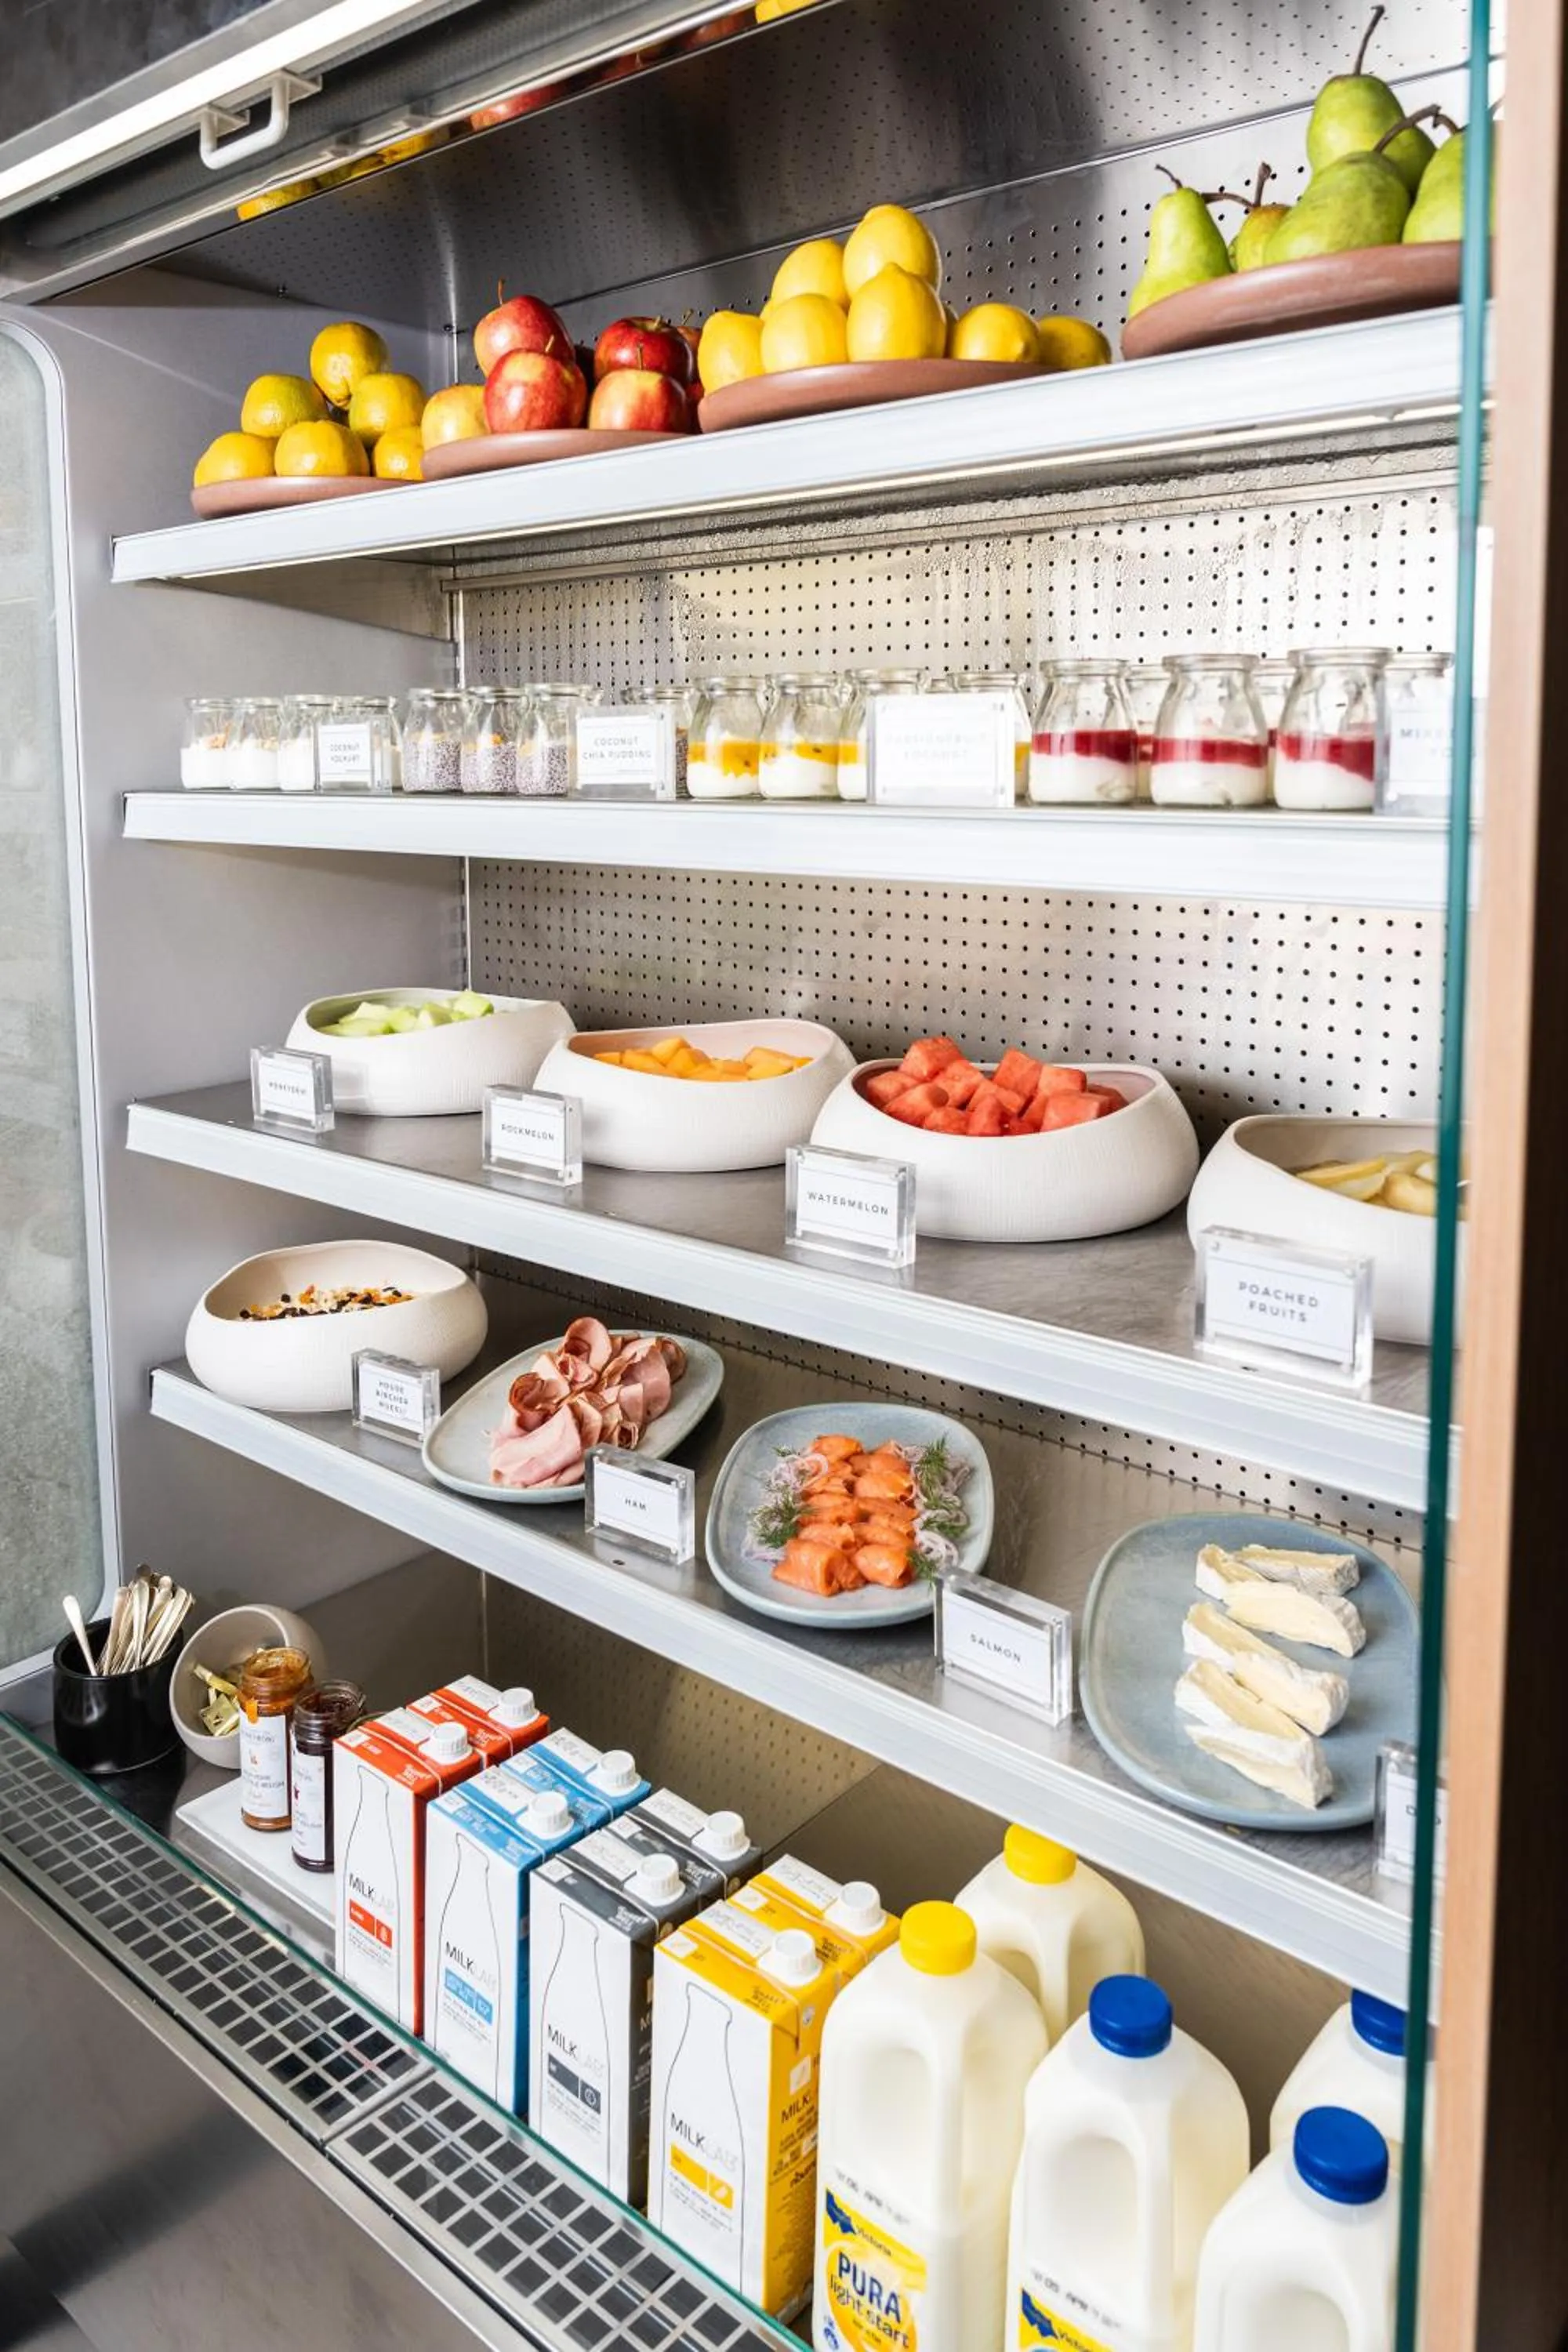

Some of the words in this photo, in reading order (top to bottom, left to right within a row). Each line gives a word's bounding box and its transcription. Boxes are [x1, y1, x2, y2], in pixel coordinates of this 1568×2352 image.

[593, 736, 638, 746] COCONUT
[582, 751, 604, 760] CHIA
[608, 750, 652, 759] PUDDING
[501, 1123, 554, 1141] ROCKMELON
[808, 1191, 889, 1216] WATERMELON
[1239, 1281, 1319, 1308] POACHED
[1249, 1300, 1308, 1323] FRUITS
[625, 1498, 646, 1511] HAM
[971, 1633, 1022, 1663] SALMON
[839, 2251, 902, 2324] PURA
[829, 2273, 863, 2318] light
[866, 2308, 910, 2350] start
